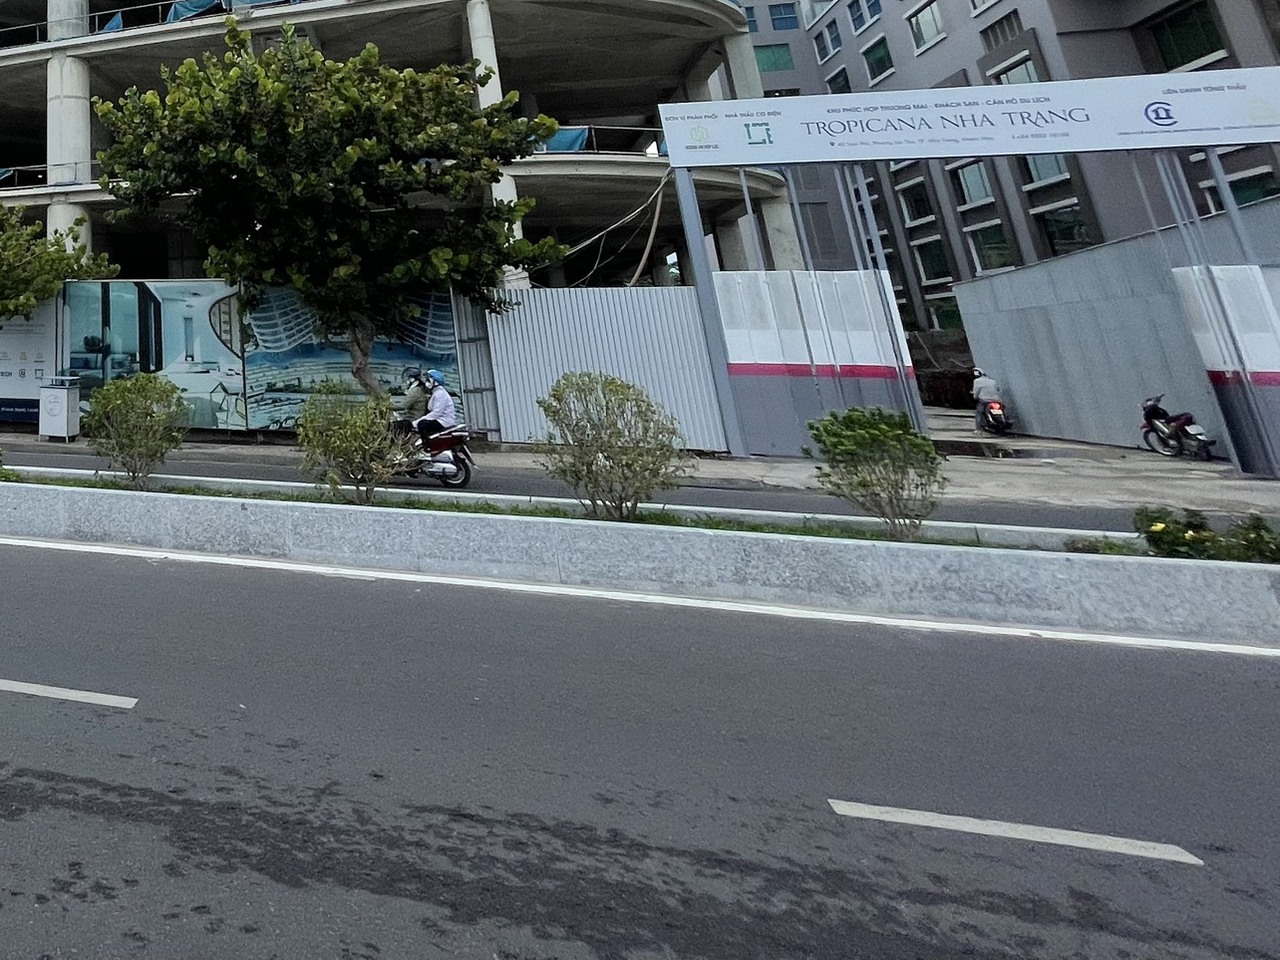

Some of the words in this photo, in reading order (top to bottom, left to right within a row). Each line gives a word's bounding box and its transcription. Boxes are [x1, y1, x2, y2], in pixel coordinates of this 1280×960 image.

[800, 116, 933, 138] TROPICANA
[939, 113, 996, 130] NHA
[1001, 107, 1091, 129] TRANG
